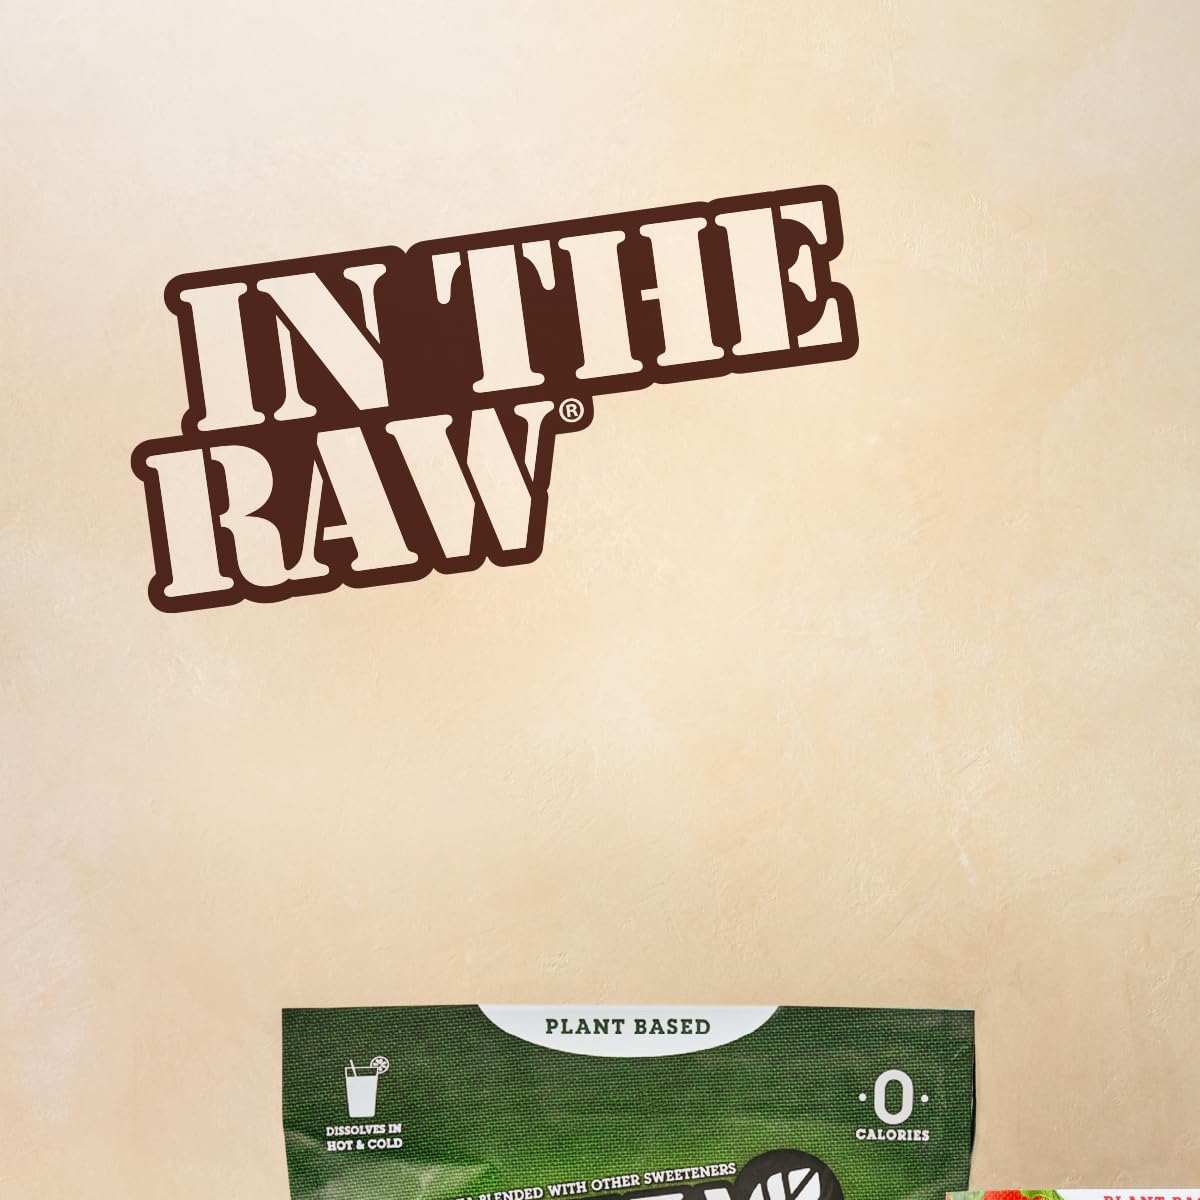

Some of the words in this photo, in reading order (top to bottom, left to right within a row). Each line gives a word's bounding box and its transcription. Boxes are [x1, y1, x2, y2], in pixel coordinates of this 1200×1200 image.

[545, 1018, 627, 1036] PLANT
[633, 1018, 711, 1036] BASED
[874, 1069, 914, 1125] 0
[326, 1124, 386, 1136] DISSOLVES
[388, 1123, 402, 1134] IN
[855, 1128, 930, 1141] CALORIES
[326, 1140, 353, 1151] HOT
[367, 1138, 403, 1150] COLD
[548, 1180, 587, 1197] WITH
[591, 1174, 640, 1192] OTHER
[644, 1163, 737, 1185] SWEETENERS
